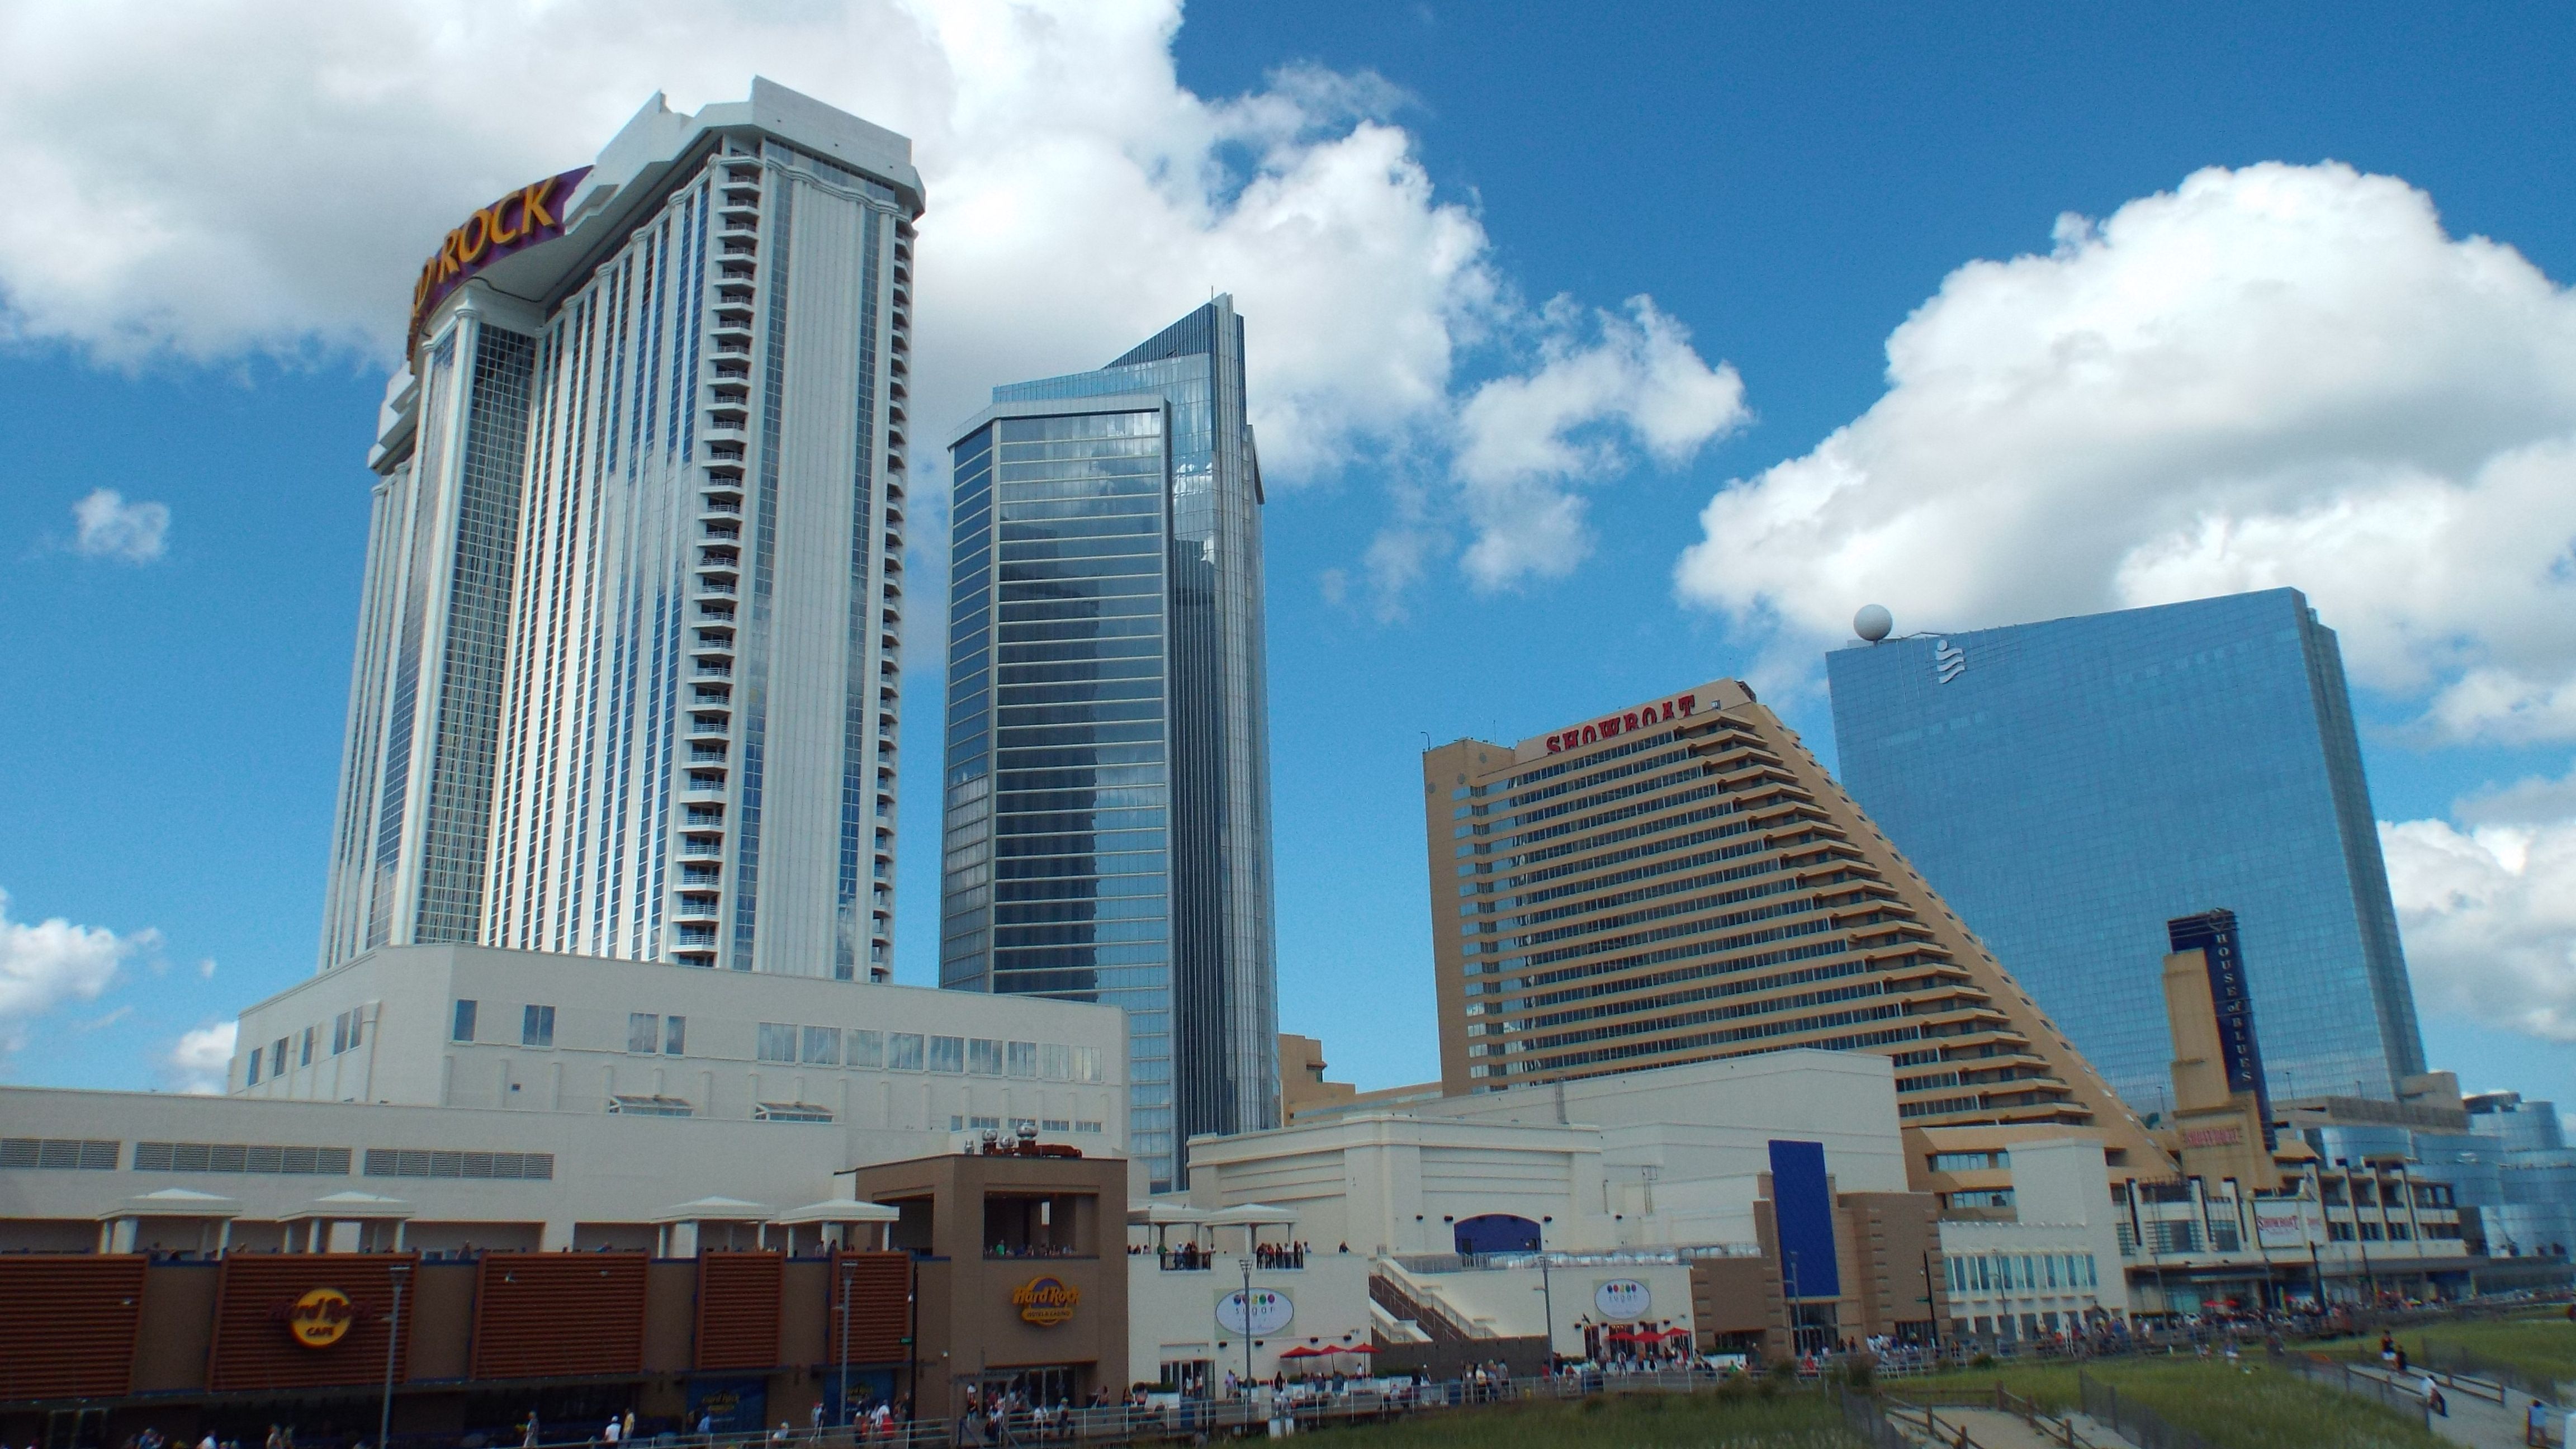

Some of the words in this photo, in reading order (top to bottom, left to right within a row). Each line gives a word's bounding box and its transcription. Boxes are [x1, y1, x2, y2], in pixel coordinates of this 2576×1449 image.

[438, 176, 558, 284] ROCK
[1546, 694, 1695, 755] SHOWBOAT
[2216, 934, 2237, 996] HOUSE
[2232, 1017, 2251, 1081] BLUES
[1012, 1286, 1049, 1305] Hard
[1049, 1285, 1079, 1306] Rock
